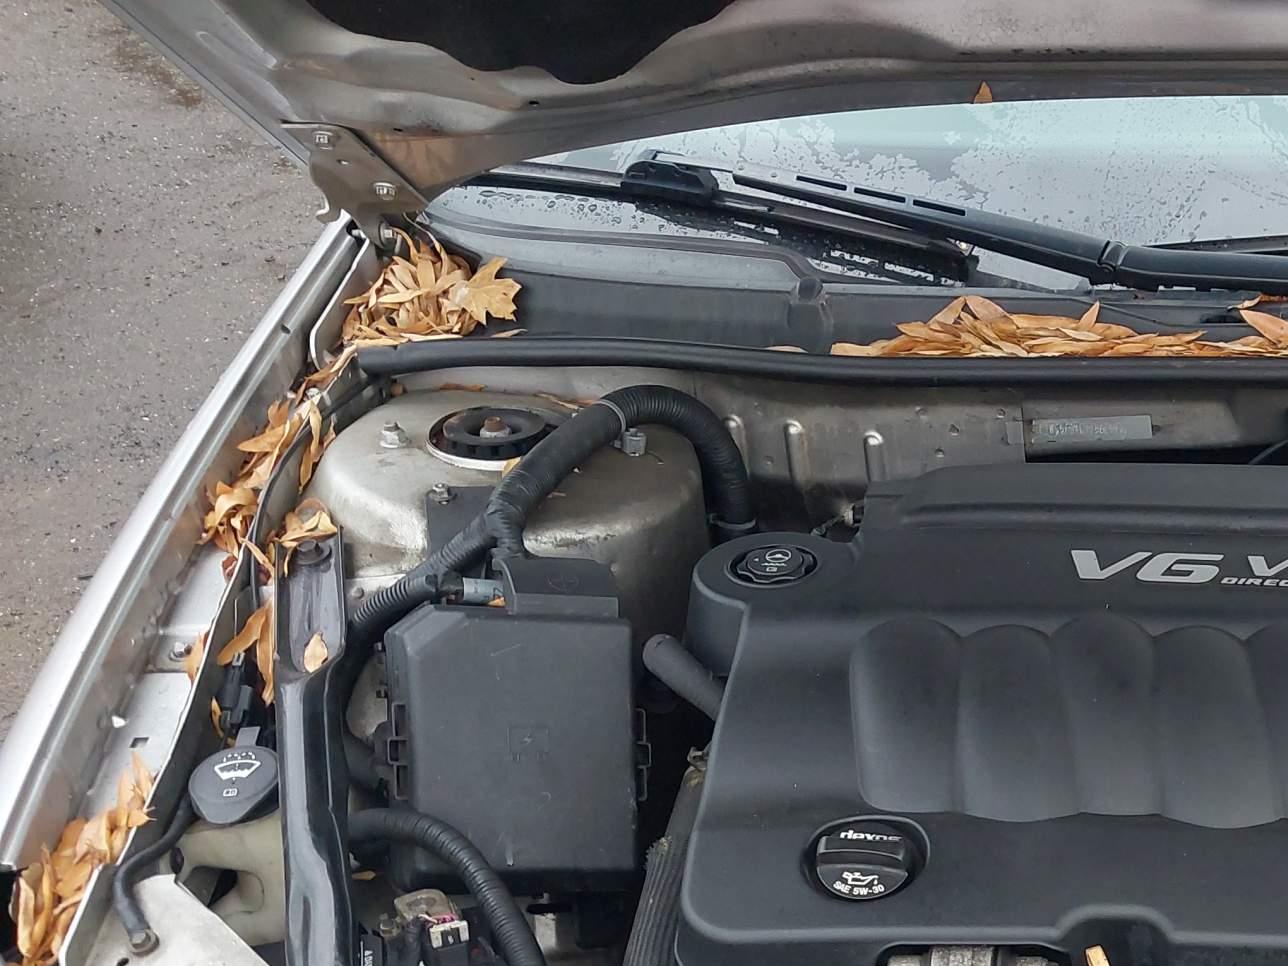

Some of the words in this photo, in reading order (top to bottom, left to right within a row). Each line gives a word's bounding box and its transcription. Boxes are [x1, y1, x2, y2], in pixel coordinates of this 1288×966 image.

[1070, 550, 1225, 583] V6
[833, 880, 852, 893] SAE
[852, 884, 885, 896] 5W-30
